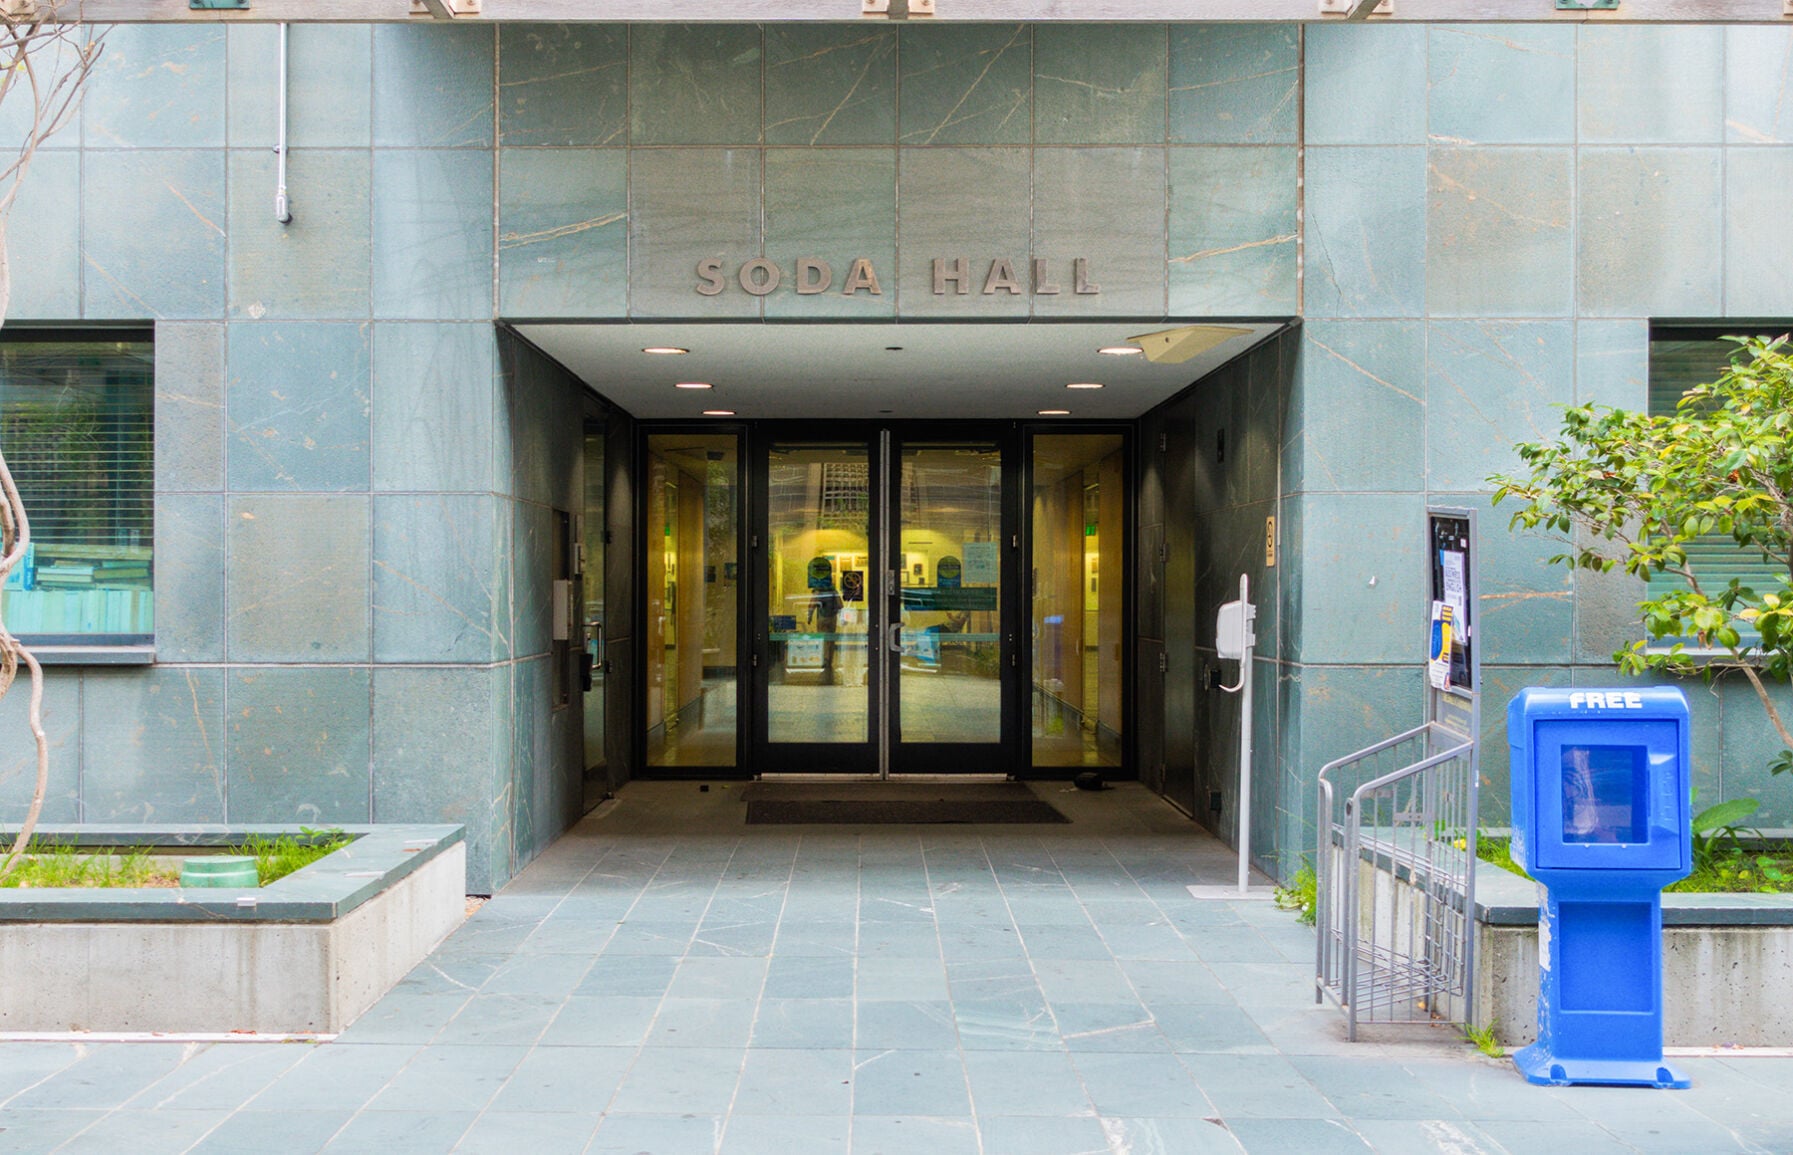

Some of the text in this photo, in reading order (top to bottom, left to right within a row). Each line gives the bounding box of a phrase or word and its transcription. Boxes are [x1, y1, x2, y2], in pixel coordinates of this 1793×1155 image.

[696, 257, 1101, 296] SODA HALL
[1569, 692, 1643, 709] FREE
